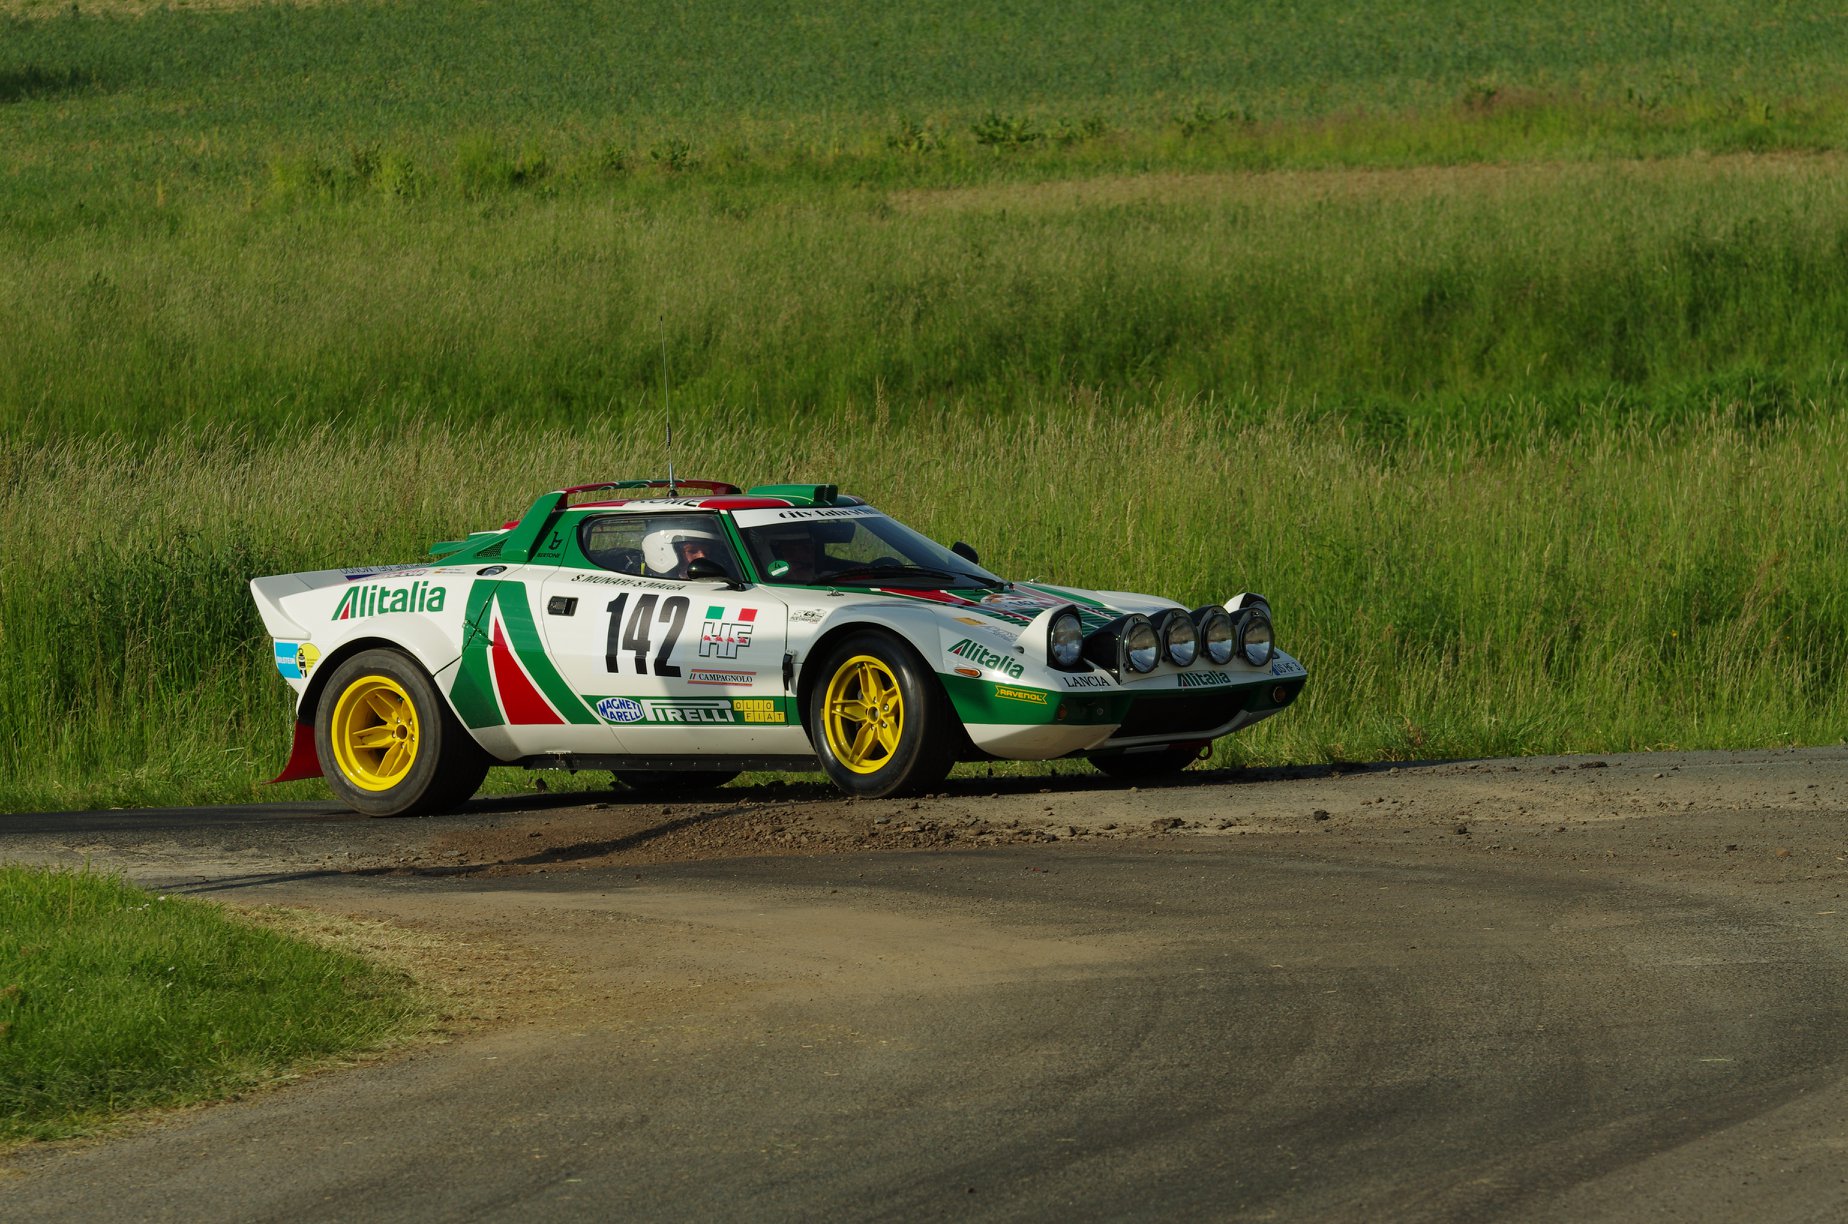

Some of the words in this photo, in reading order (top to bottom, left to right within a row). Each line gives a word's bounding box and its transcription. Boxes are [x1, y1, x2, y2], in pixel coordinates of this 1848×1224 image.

[331, 580, 447, 621] Alitalia
[605, 592, 691, 678] 142
[699, 621, 754, 660] HF
[947, 638, 1025, 680] Alitalia
[698, 672, 754, 684] CAMPAGNOLO
[1063, 675, 1111, 689] LANCIA
[1177, 670, 1232, 687] Alitalia
[1000, 688, 1043, 702] RAVENOL
[598, 698, 642, 713] MAGNETI
[640, 699, 735, 722] PIRELLI
[735, 700, 773, 711] OLIO
[599, 706, 643, 721] MARELLI
[746, 711, 784, 722] FIAT
